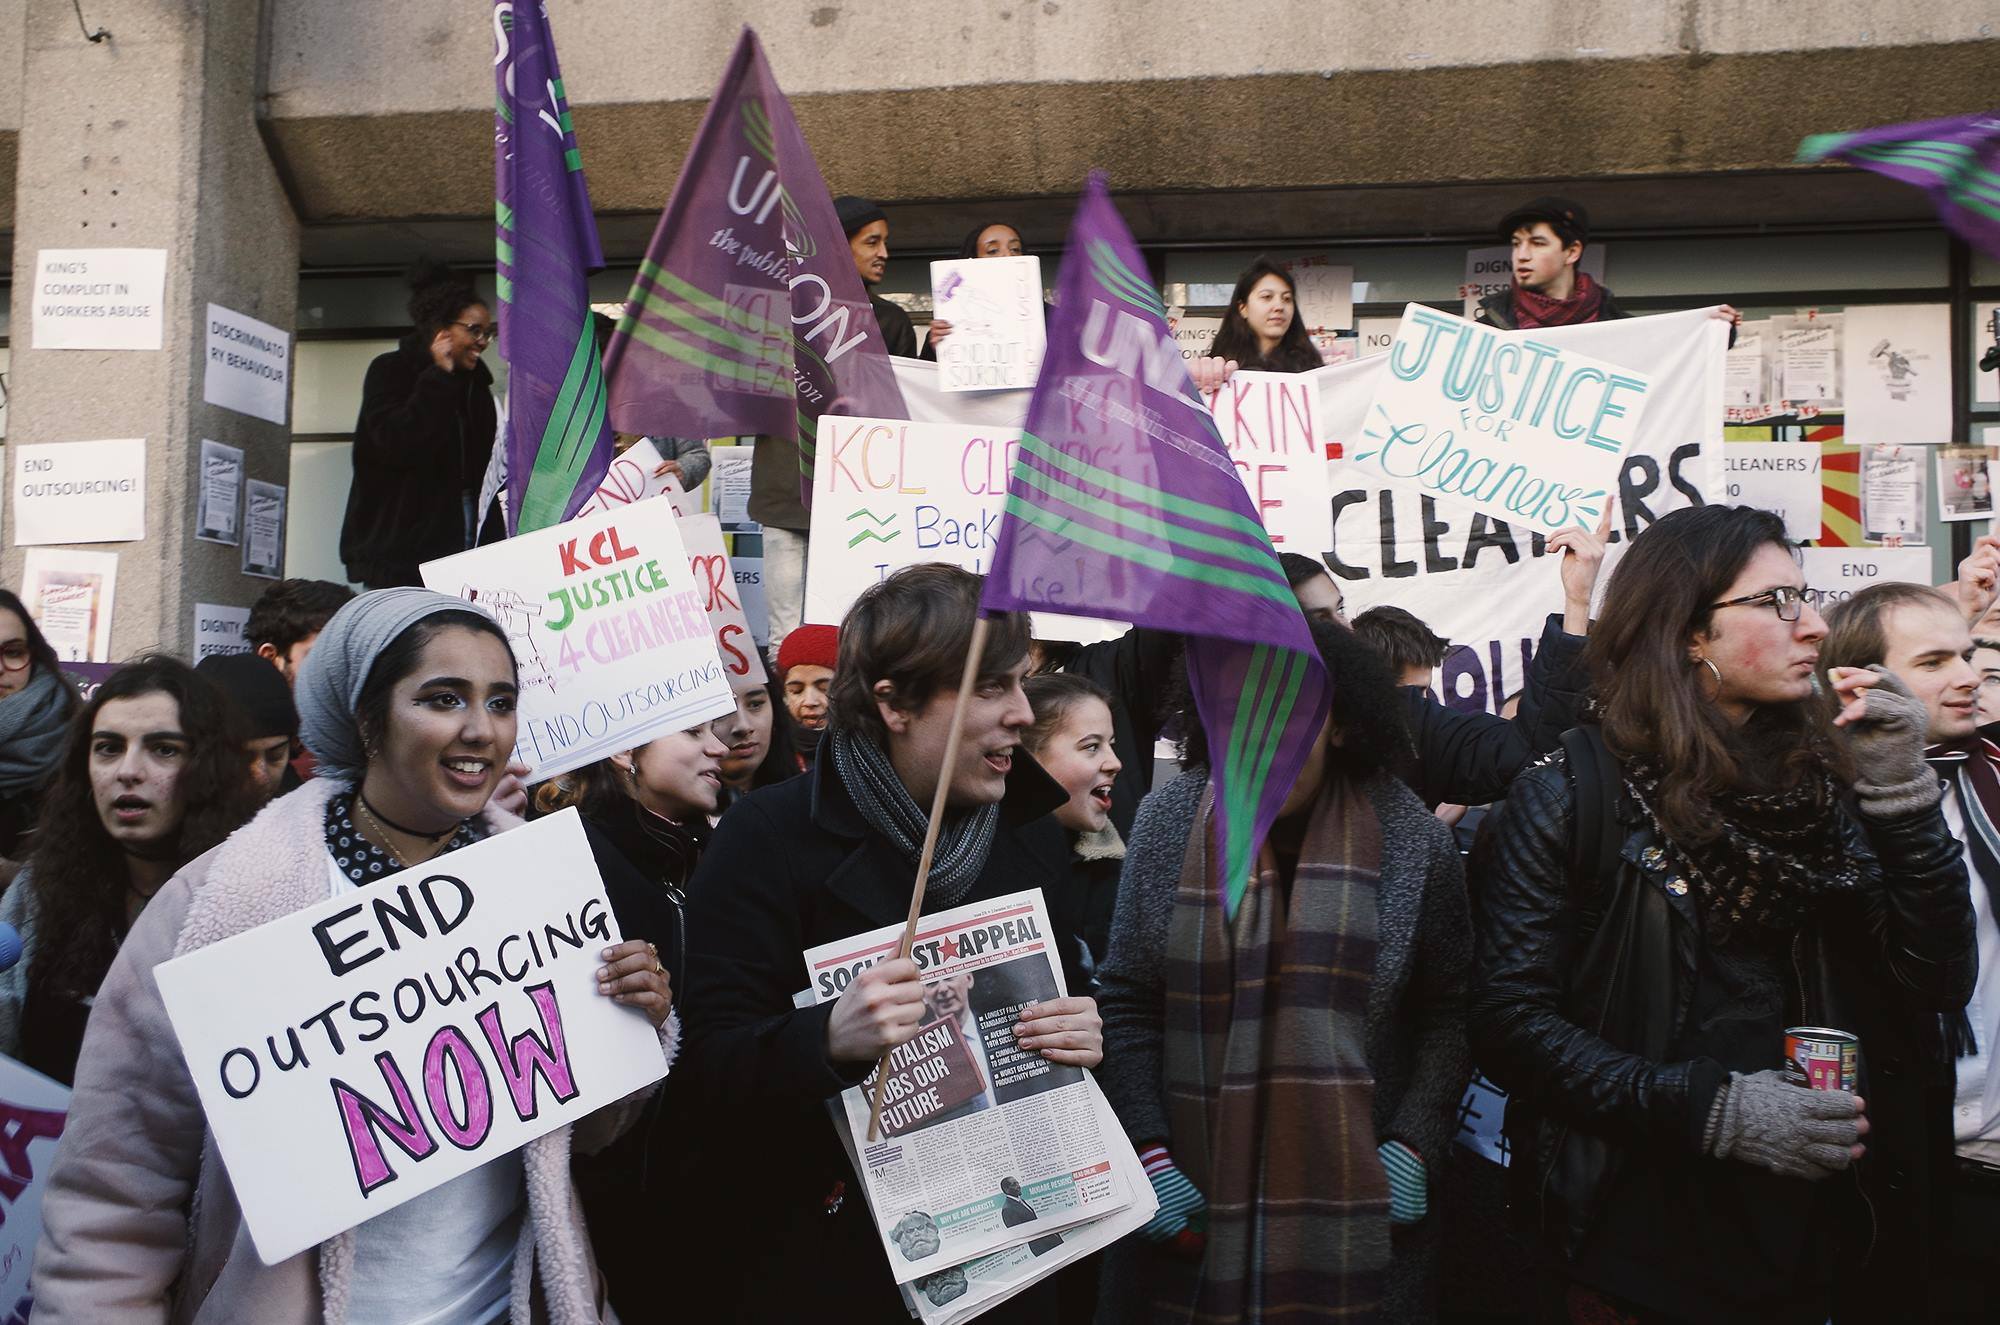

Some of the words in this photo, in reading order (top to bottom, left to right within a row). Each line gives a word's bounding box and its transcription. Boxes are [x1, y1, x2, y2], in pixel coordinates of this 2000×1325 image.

[45, 262, 88, 275] KING'S
[1474, 259, 1512, 274] DIGN
[43, 283, 112, 296] COMPLICIT
[115, 283, 128, 296] IN
[42, 304, 105, 318] WORKERS
[108, 304, 151, 318] ABUSE
[210, 320, 285, 359] DISCRIMINATO
[1367, 333, 1391, 347] NO
[211, 348, 226, 364] RY
[227, 353, 285, 384] BEHAVIOUR
[1390, 310, 1648, 455] JUSTICE
[1461, 405, 1515, 443] FOR
[23, 459, 54, 473] END
[829, 424, 927, 495] KCL
[1379, 422, 1584, 528] Cleaners
[22, 478, 136, 498] OUTSOURCING!
[915, 505, 998, 550] Back
[558, 526, 640, 578] KCL
[1841, 562, 1879, 578] END
[545, 559, 669, 632] JUSTICE
[201, 619, 241, 634] DIGNITY
[556, 631, 587, 674] 4
[584, 590, 712, 667] CLEANERS
[312, 874, 475, 977] END
[957, 915, 1042, 960] APPEAL
[219, 898, 612, 1099] OUTSOURCING
[979, 1015, 1008, 1029] STANDARDS
[330, 980, 580, 1199] NOW
[912, 1055, 950, 1088] OUR
[999, 1066, 1017, 1077] WORST
[1028, 1065, 1050, 1077] GROWTH
[878, 1086, 944, 1134] FUTURE
